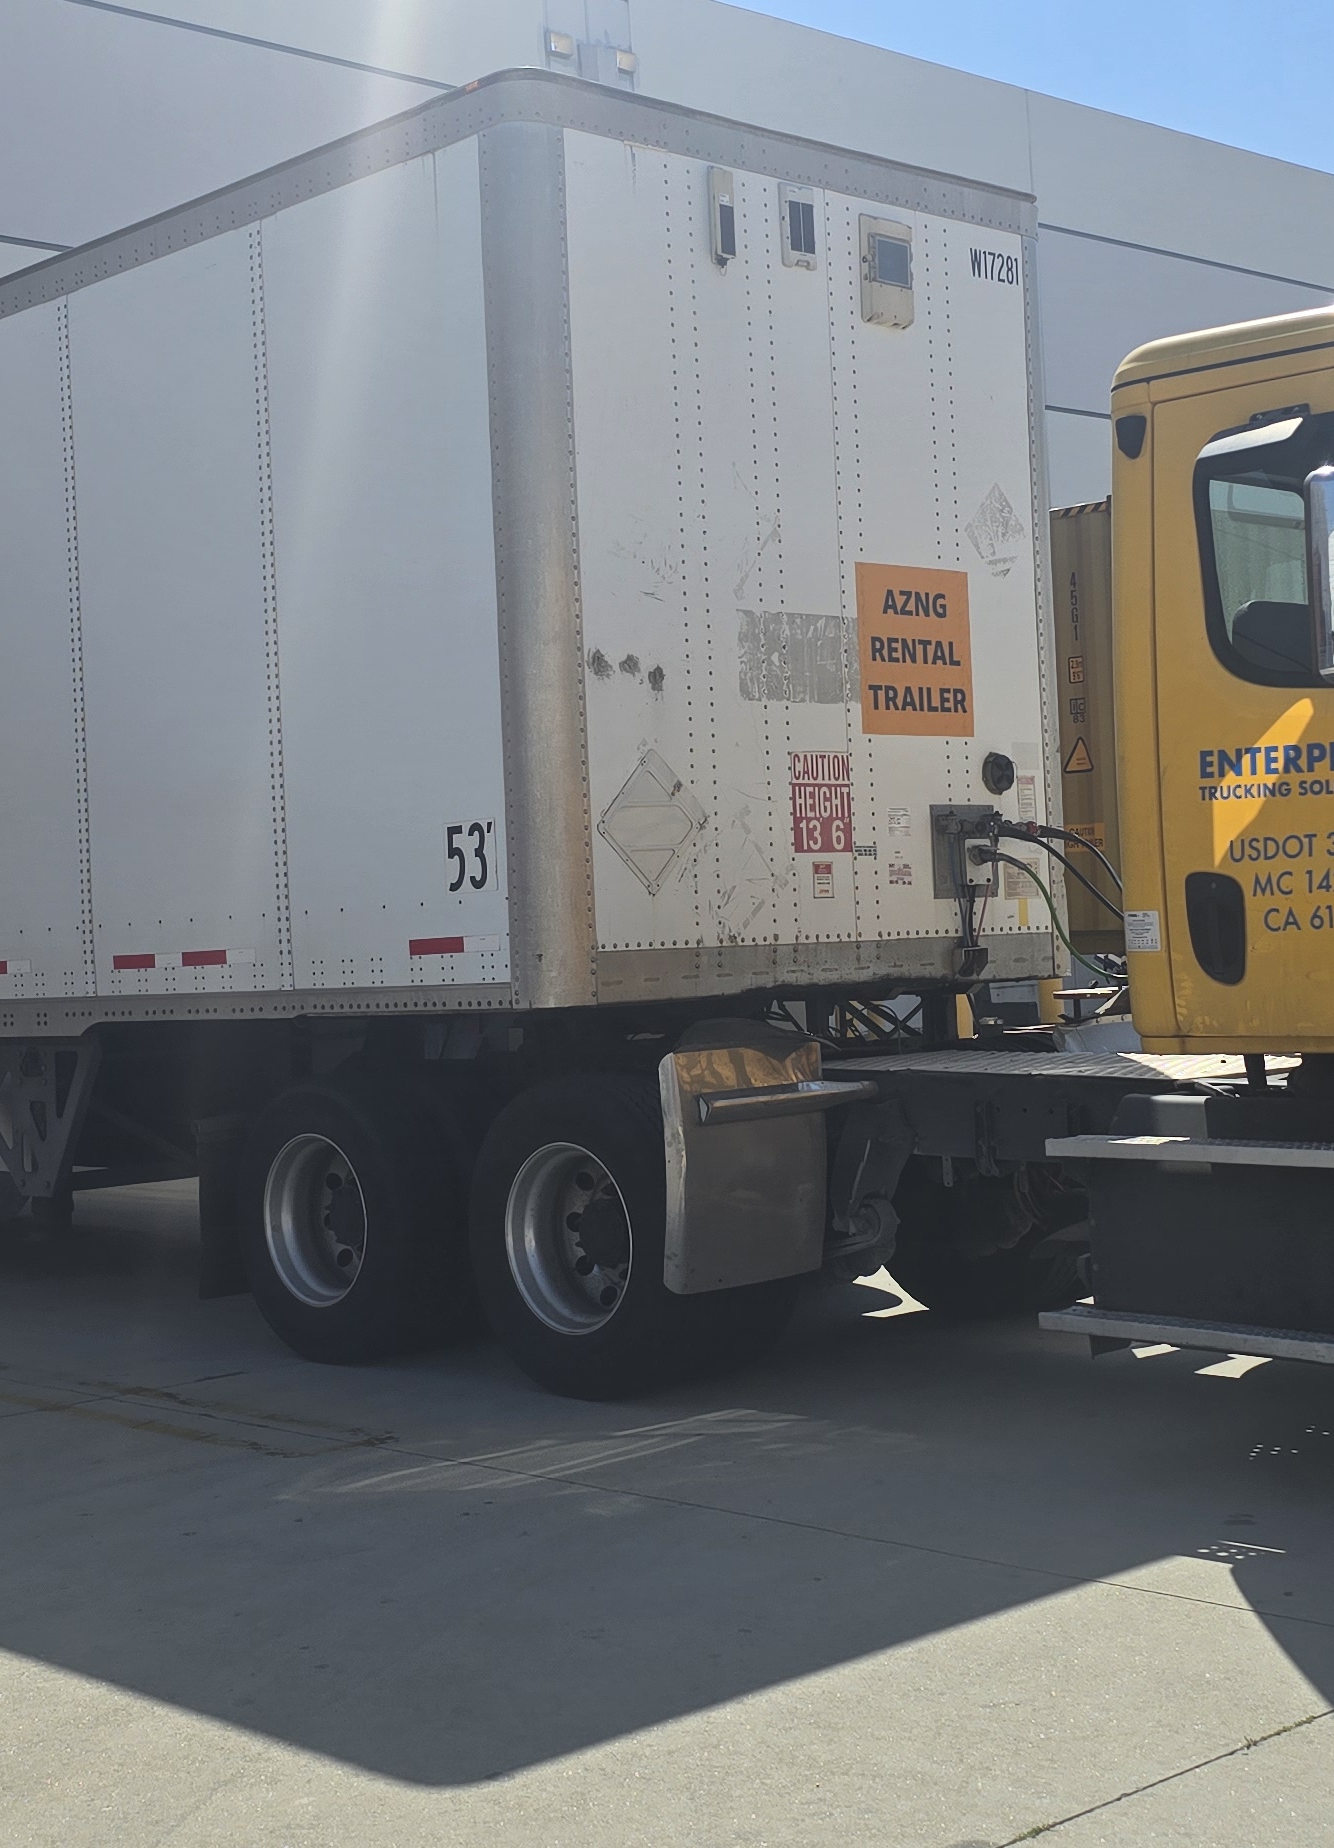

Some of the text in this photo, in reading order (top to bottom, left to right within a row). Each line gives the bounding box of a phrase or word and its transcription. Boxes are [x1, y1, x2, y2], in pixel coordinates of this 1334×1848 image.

[970, 247, 1019, 286] W17281
[882, 588, 947, 618] AZNG
[870, 636, 962, 667] RENTAL
[868, 684, 968, 713] TRAILER
[793, 754, 850, 781] CAUTION
[795, 786, 849, 818] HEIGHT
[1199, 781, 1292, 801] TRUCKING
[1229, 833, 1317, 863] USDOT
[1252, 870, 1293, 897] MC
[1263, 906, 1301, 932] CA
